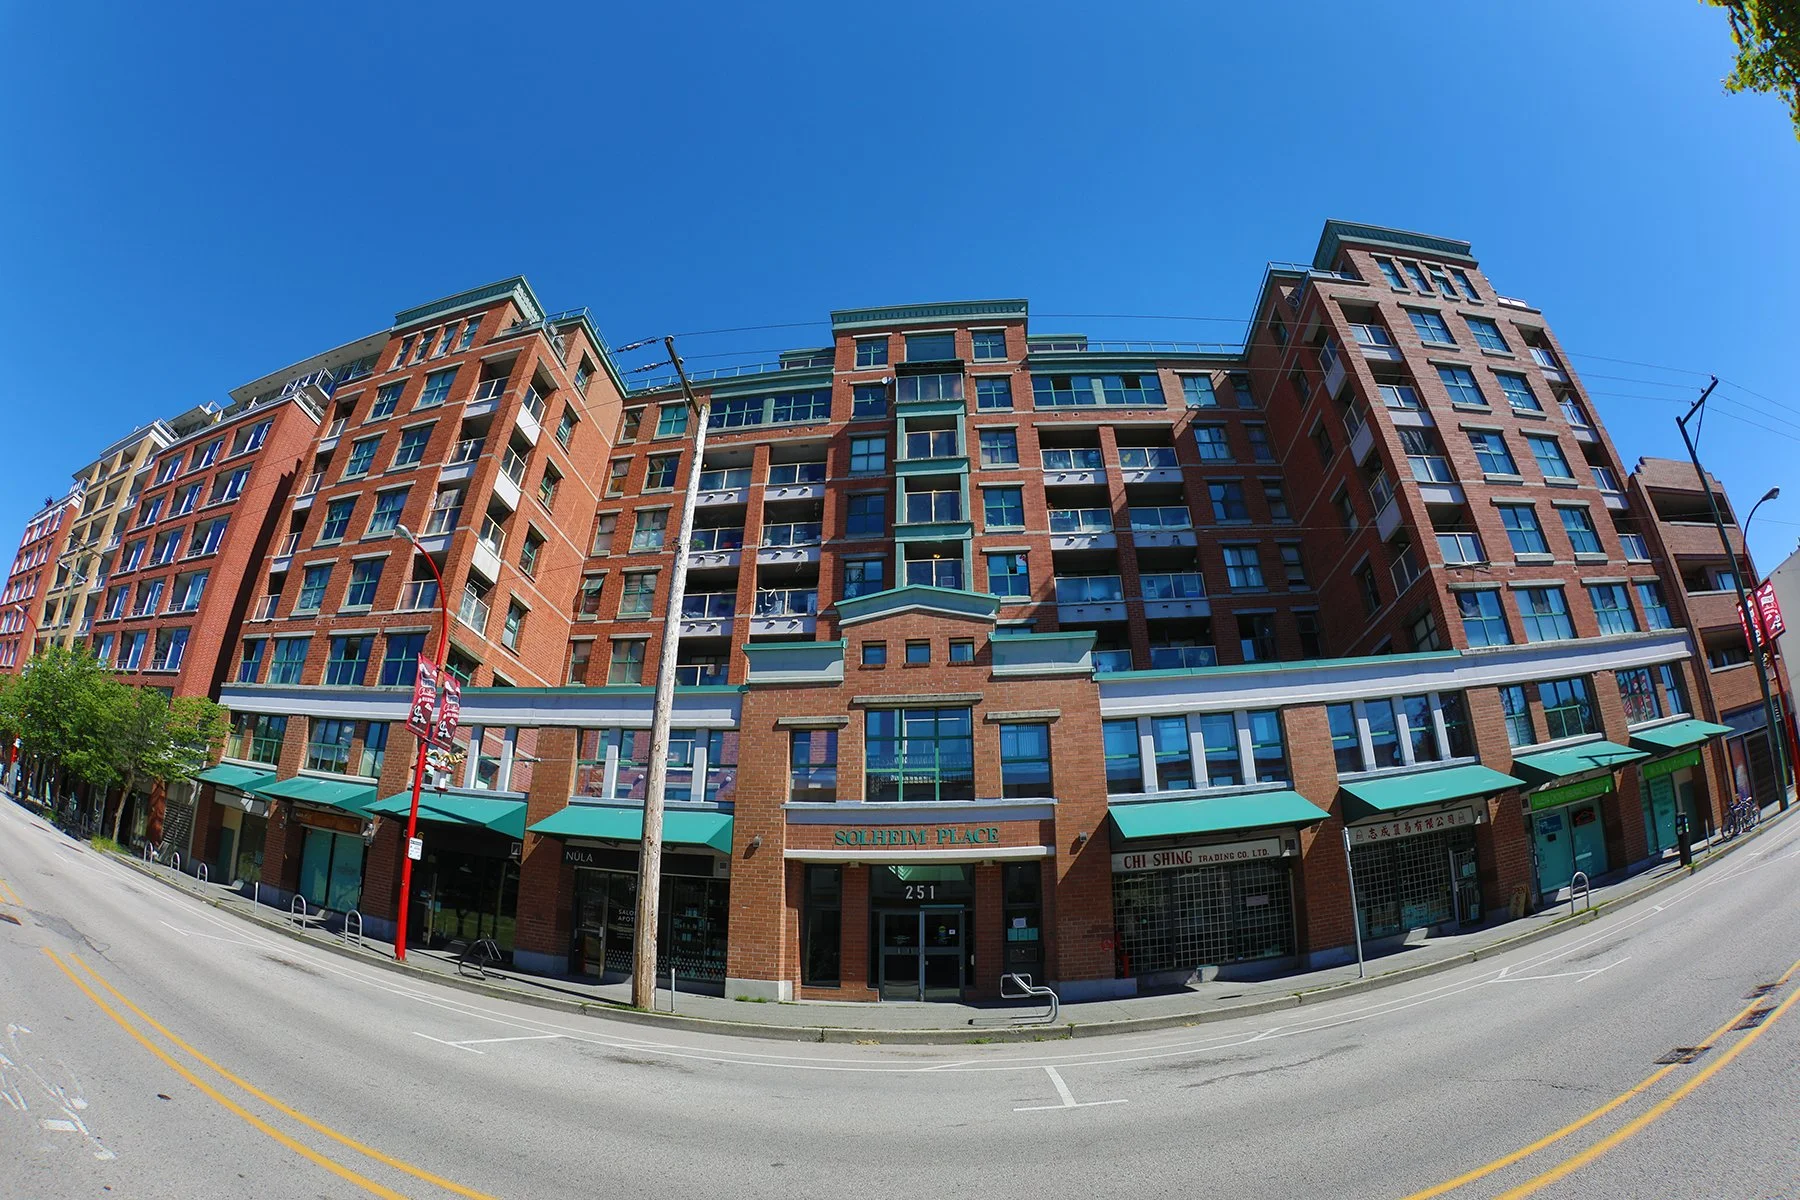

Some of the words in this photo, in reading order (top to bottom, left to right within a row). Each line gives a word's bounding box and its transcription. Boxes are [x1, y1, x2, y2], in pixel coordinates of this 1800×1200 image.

[835, 829, 926, 846] SOLHEIM
[936, 827, 999, 844] PLACE
[1124, 854, 1146, 869] CHI
[1153, 851, 1193, 866] SHING
[1198, 854, 1235, 863] TRADING
[1237, 851, 1249, 859] CO.
[1252, 848, 1270, 857] LTD.
[905, 885, 934, 899] 251
[618, 908, 635, 916] SALO
